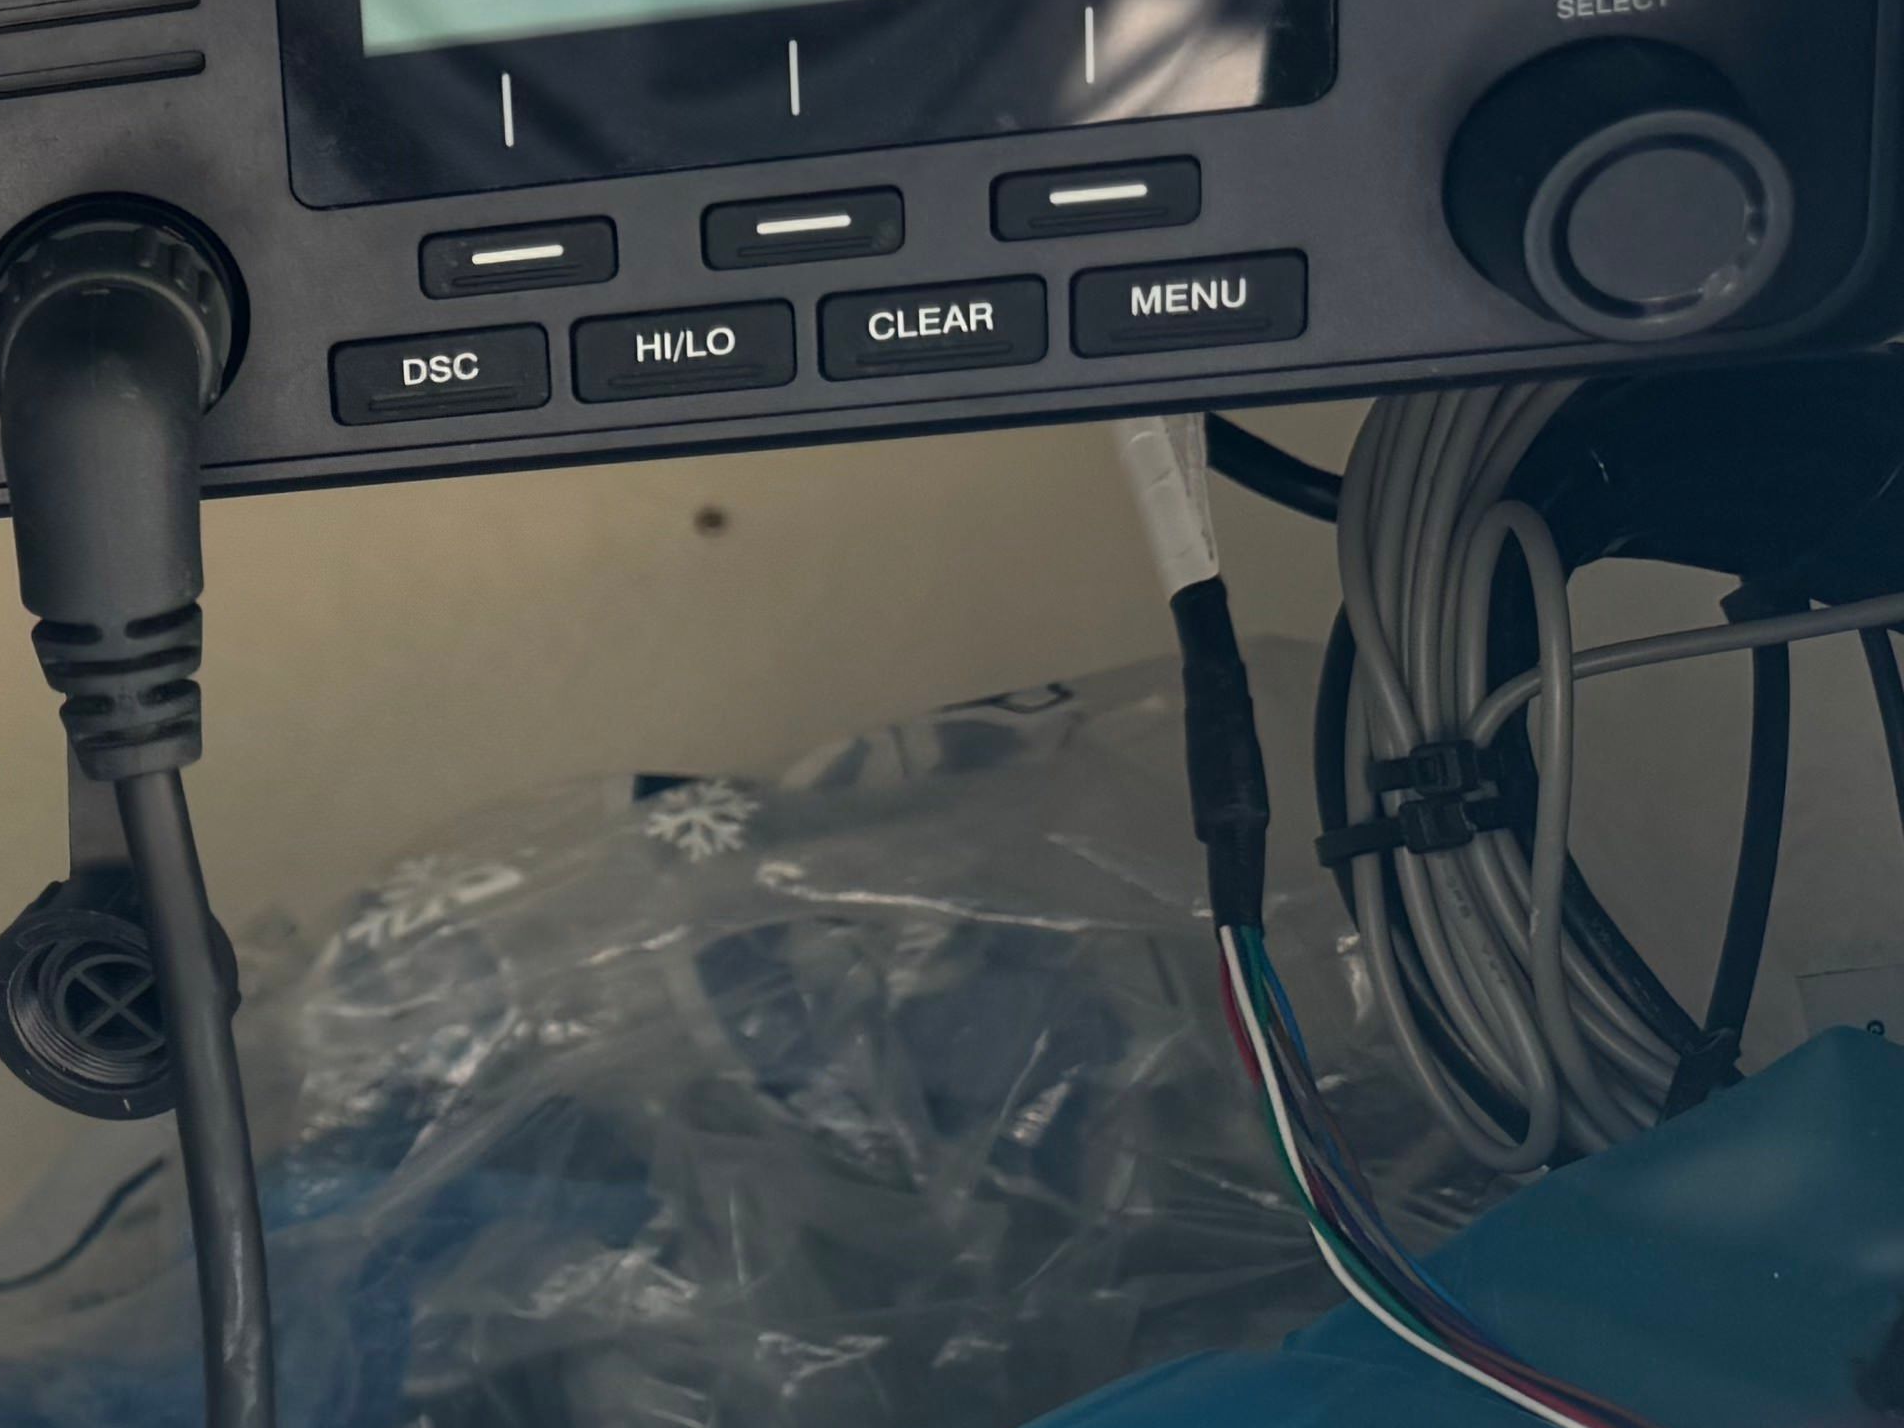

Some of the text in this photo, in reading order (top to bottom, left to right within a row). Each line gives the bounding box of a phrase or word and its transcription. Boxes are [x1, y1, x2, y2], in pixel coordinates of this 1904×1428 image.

[1130, 277, 1248, 317] MENU
[867, 301, 995, 341] CLEAR
[635, 326, 736, 364] HI/LO
[401, 352, 480, 387] DSC
